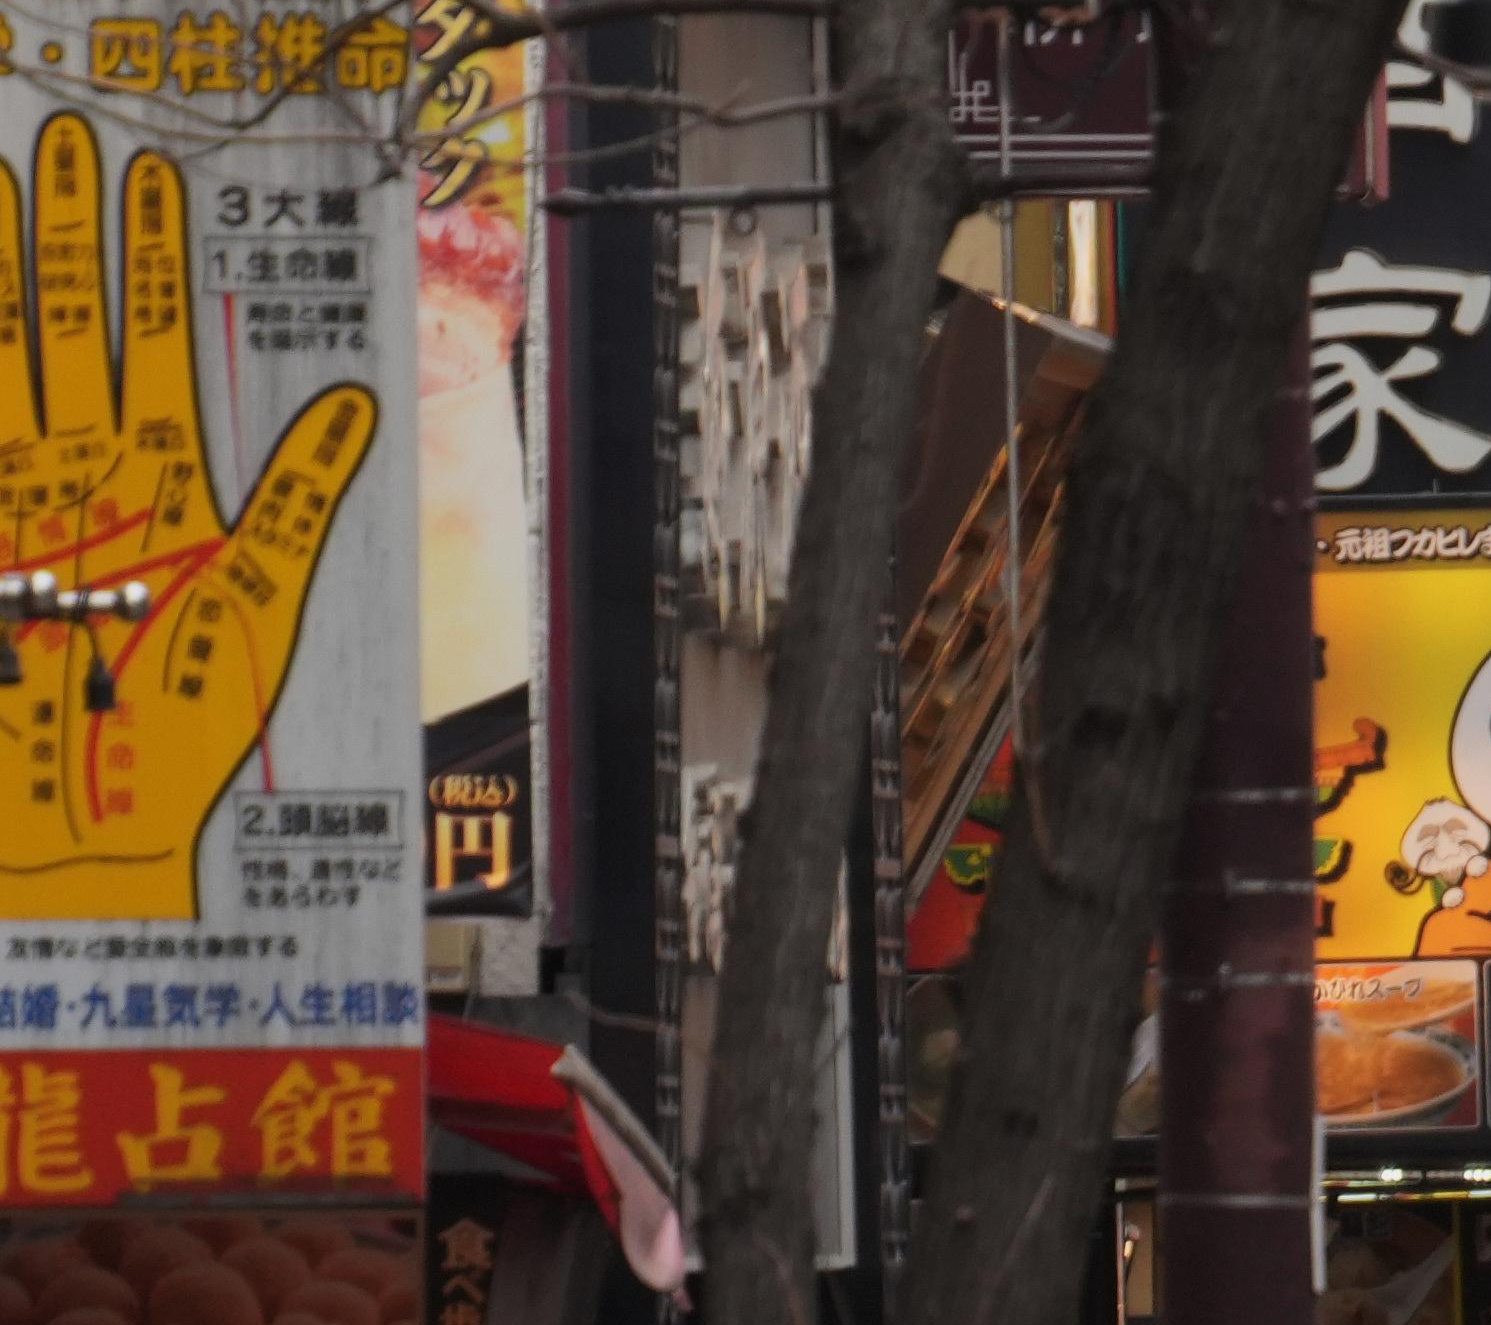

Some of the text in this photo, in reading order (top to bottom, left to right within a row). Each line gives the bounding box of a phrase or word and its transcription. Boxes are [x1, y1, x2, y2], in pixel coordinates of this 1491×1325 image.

[0, 16, 409, 95] ・四柱推命
[434, 812, 512, 891] 円
